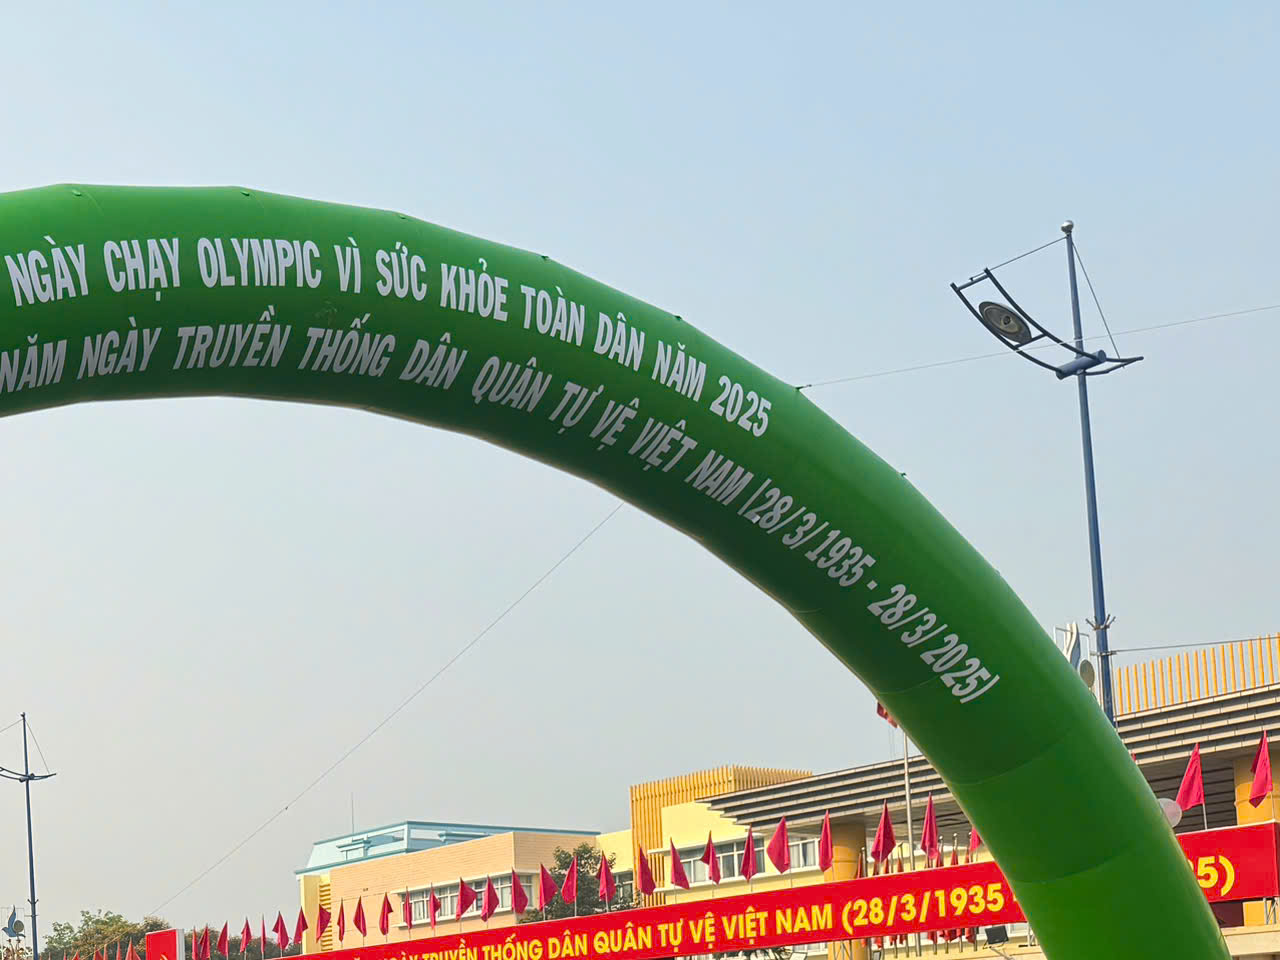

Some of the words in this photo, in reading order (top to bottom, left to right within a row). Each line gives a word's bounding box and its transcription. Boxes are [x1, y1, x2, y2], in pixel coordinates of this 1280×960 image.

[5, 236, 88, 306] NGÀY
[104, 238, 180, 301] CHẠY
[198, 238, 321, 288] OLYMPIC
[335, 237, 361, 293] VÌ
[376, 242, 427, 301] SỨC
[440, 258, 508, 321] KHỎE
[521, 287, 585, 346] TOÀN
[594, 312, 645, 371] DÂN
[652, 341, 707, 401] NĂM
[710, 375, 771, 437] 2025
[78, 317, 161, 378] NGÀY
[174, 305, 290, 369] TRUYỀN
[299, 314, 395, 376] THỐNG
[400, 332, 467, 389] DÂN
[472, 356, 552, 412] QUÂN
[549, 382, 604, 433] TỰ
[590, 398, 638, 450] VỆ
[629, 419, 697, 470] VIỆT
[685, 450, 754, 505] NAM
[738, 480, 876, 586] (28/3/1935
[867, 585, 1000, 703] 28/3/2025)
[548, 930, 588, 960] DÂN
[593, 922, 652, 954] QUÂN
[658, 919, 683, 952] TỰ
[688, 911, 716, 949] VỆ
[722, 906, 769, 945] VIỆT
[776, 903, 833, 935] NAM
[841, 883, 1004, 935] (28/3/1935
[1189, 855, 1235, 897] 5)
